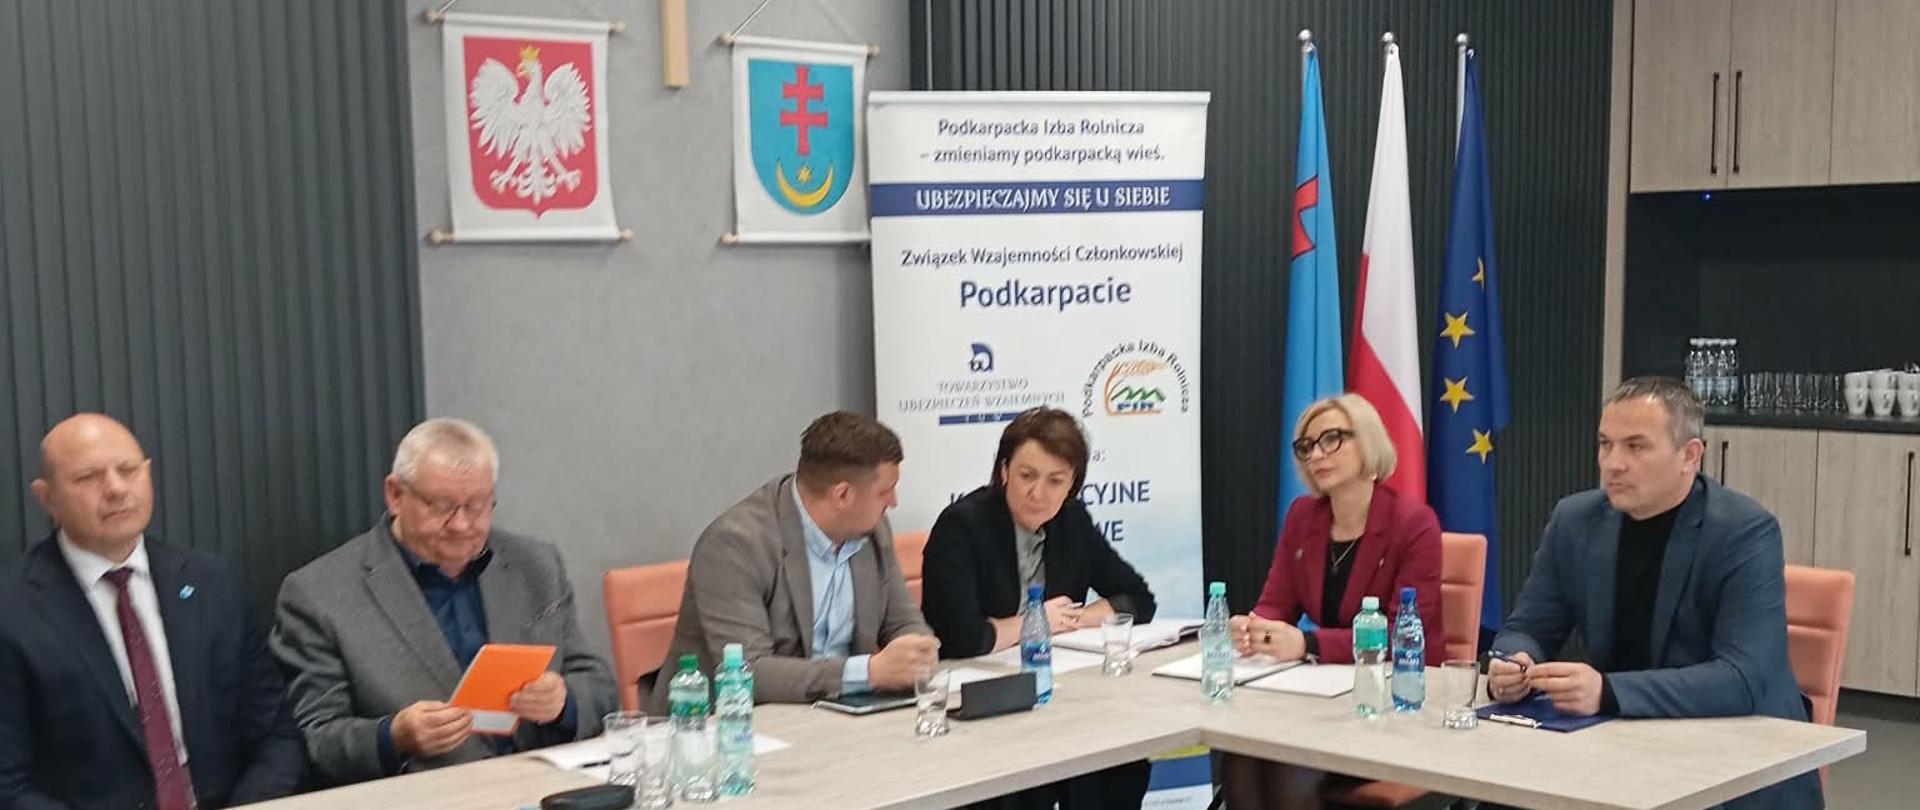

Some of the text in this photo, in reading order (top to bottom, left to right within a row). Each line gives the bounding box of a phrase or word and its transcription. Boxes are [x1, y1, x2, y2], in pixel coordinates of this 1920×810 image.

[938, 117, 1144, 139] Podkarpacka Izba Rolnicza
[933, 148, 1020, 168] zmieniamy
[1024, 146, 1121, 166] podkarpacką
[1126, 144, 1165, 161] wieś.
[916, 186, 1170, 212] UBEZPIECZAJMY SIĘ U SIEBIE
[901, 243, 1184, 268] Związek Wzajemności Członkowskiej
[960, 277, 1131, 312] Podkarpacie
